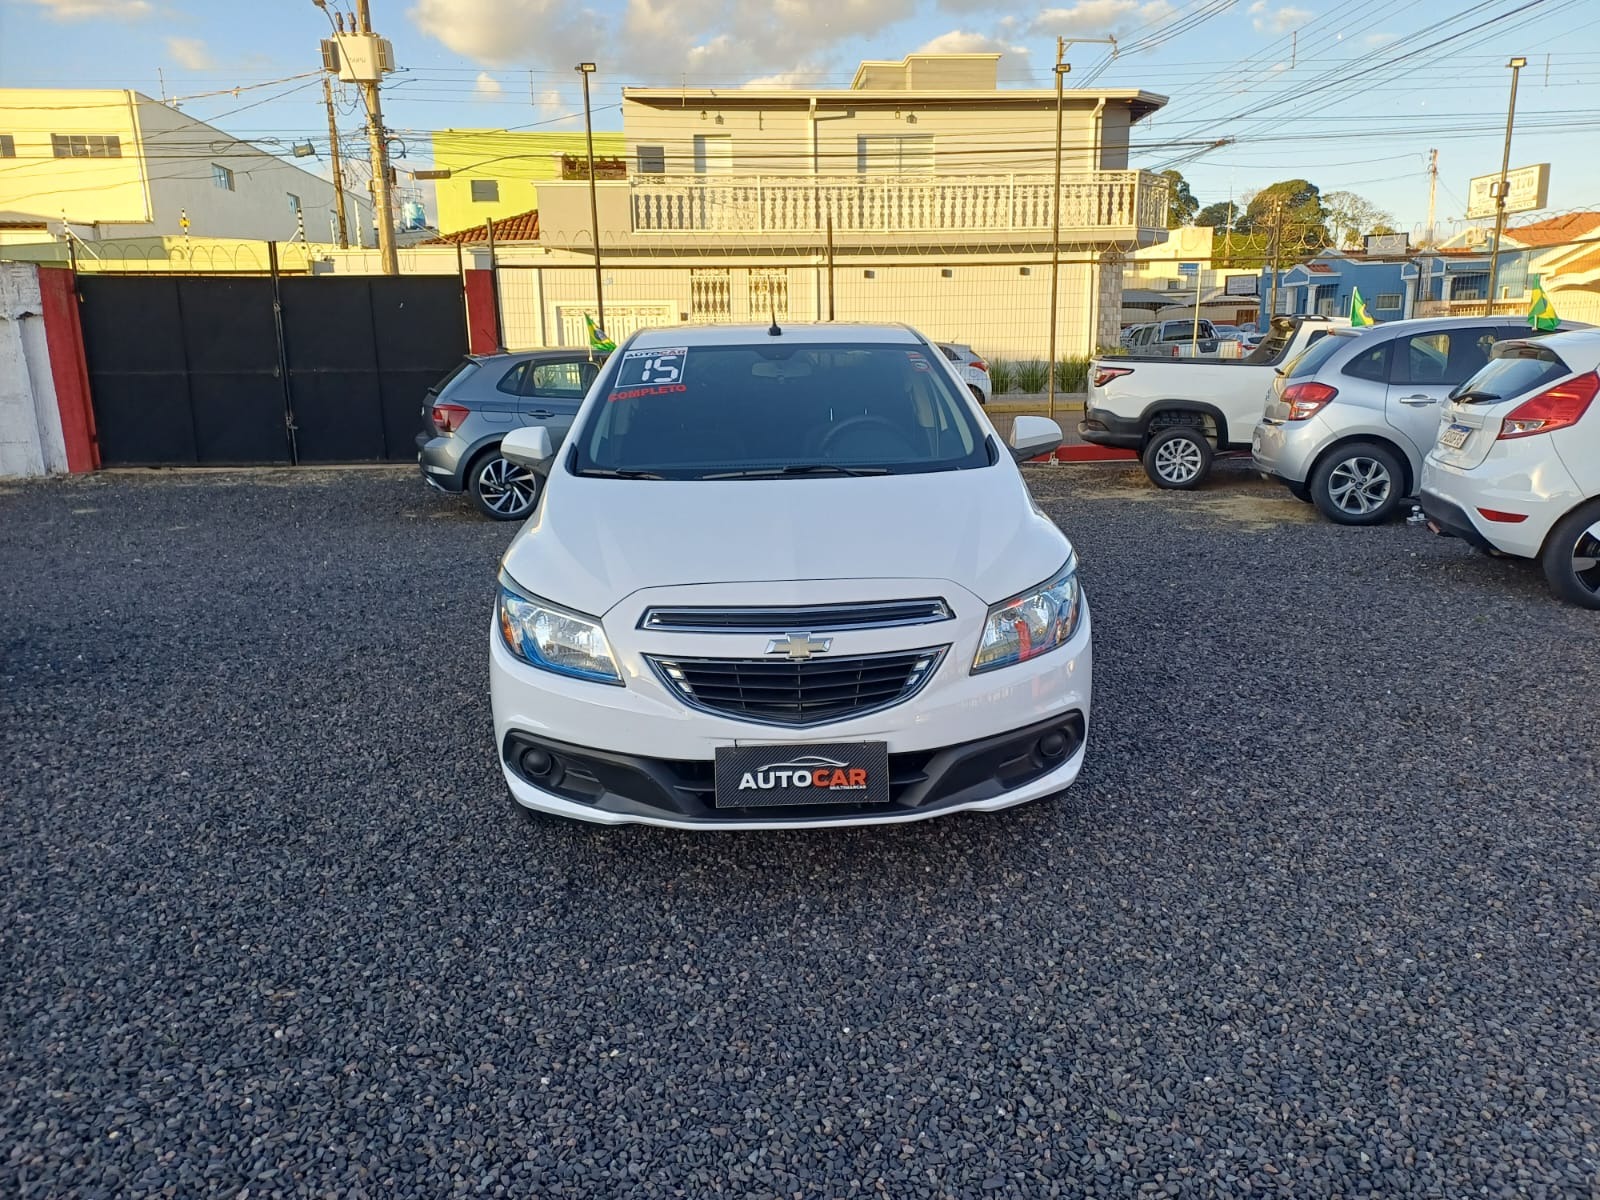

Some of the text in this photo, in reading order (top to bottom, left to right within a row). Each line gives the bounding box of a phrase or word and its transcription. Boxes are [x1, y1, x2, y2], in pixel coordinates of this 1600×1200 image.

[625, 350, 686, 358] AUTOCAR
[641, 356, 679, 382] 15
[608, 384, 687, 403] COMPLETO
[738, 768, 867, 790] AUTOCAR
